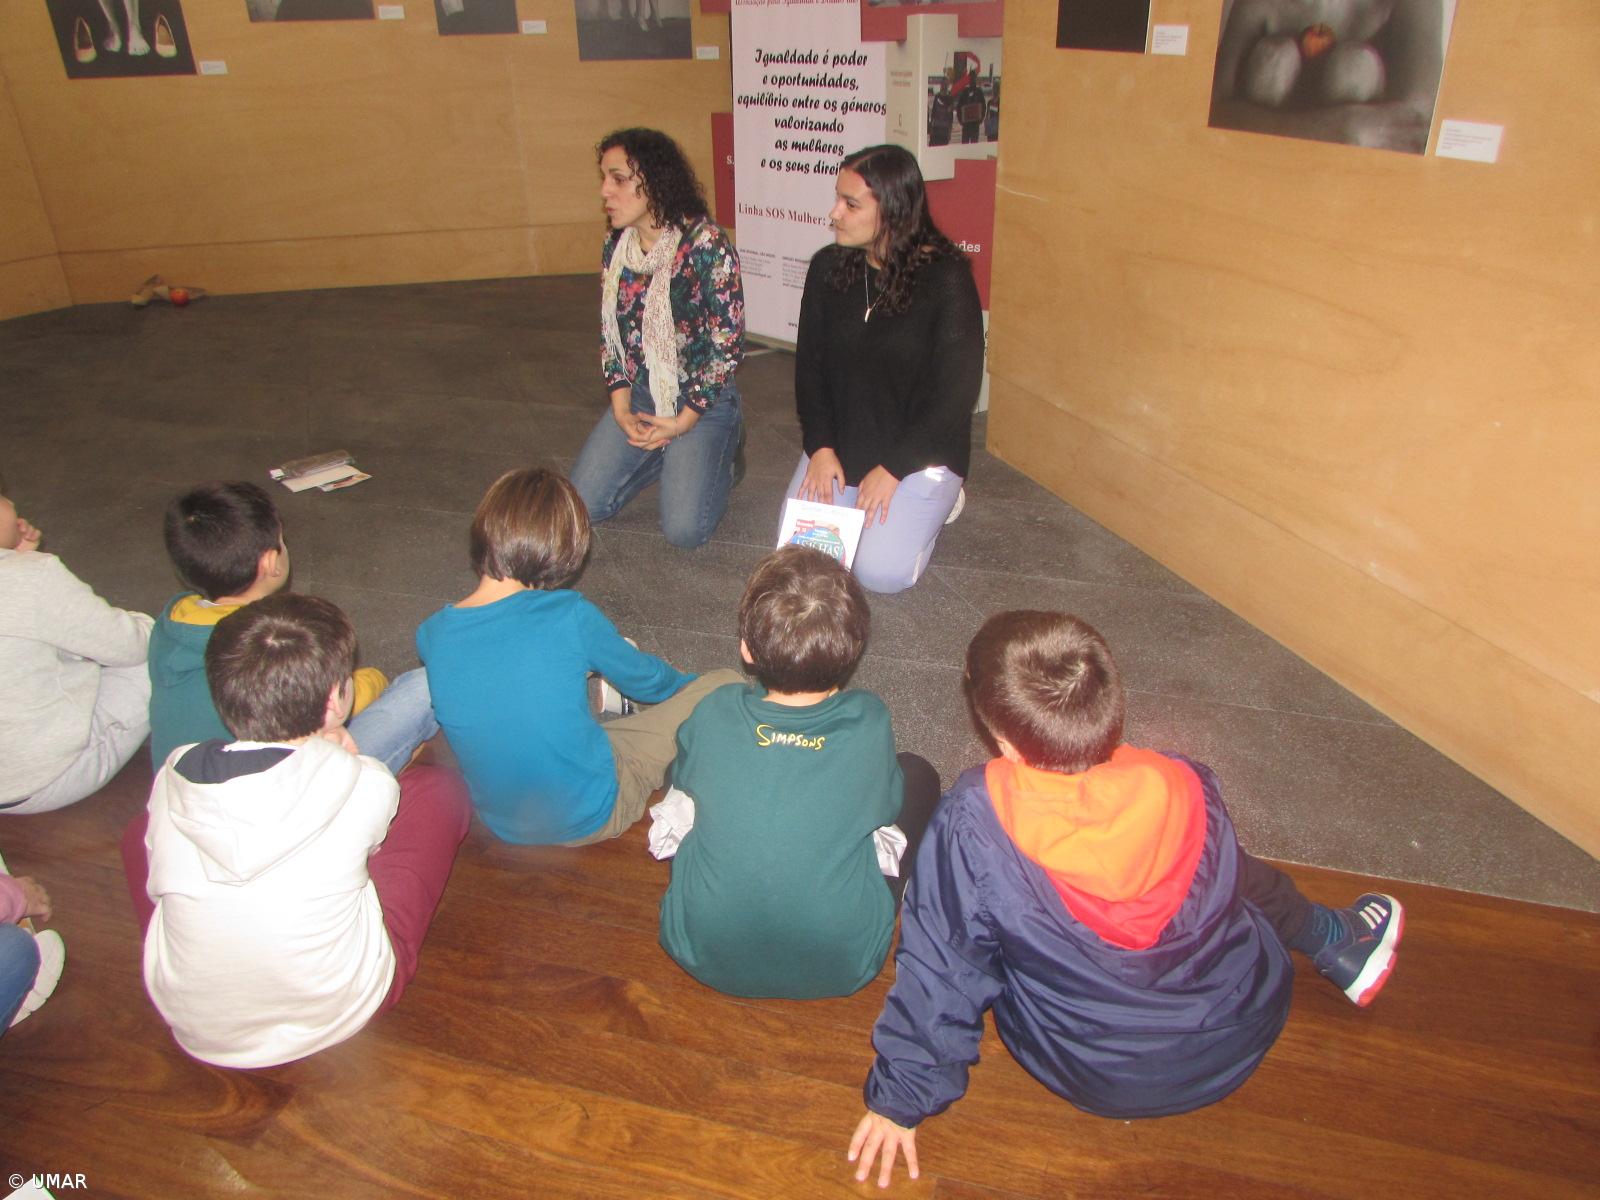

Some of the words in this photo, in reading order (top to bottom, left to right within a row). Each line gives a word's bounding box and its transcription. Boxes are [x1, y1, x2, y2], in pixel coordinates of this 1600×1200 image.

[754, 48, 819, 68] Igualdade
[822, 49, 830, 65] é
[832, 50, 868, 68] poder
[762, 73, 769, 86] e
[770, 72, 859, 91] oportunidades,
[737, 90, 789, 109] equilíbrio
[792, 94, 820, 110] entre
[823, 100, 838, 113] os
[840, 96, 887, 116] géneros
[774, 115, 845, 134] valorizando
[774, 139, 788, 152] as
[791, 138, 845, 157] mulheres
[760, 158, 767, 168] e
[769, 158, 783, 172] os
[785, 160, 810, 174] seus
[813, 160, 842, 176] direi
[738, 202, 763, 217] Linha
[765, 206, 785, 220] SOS
[788, 209, 826, 226] Mulher:
